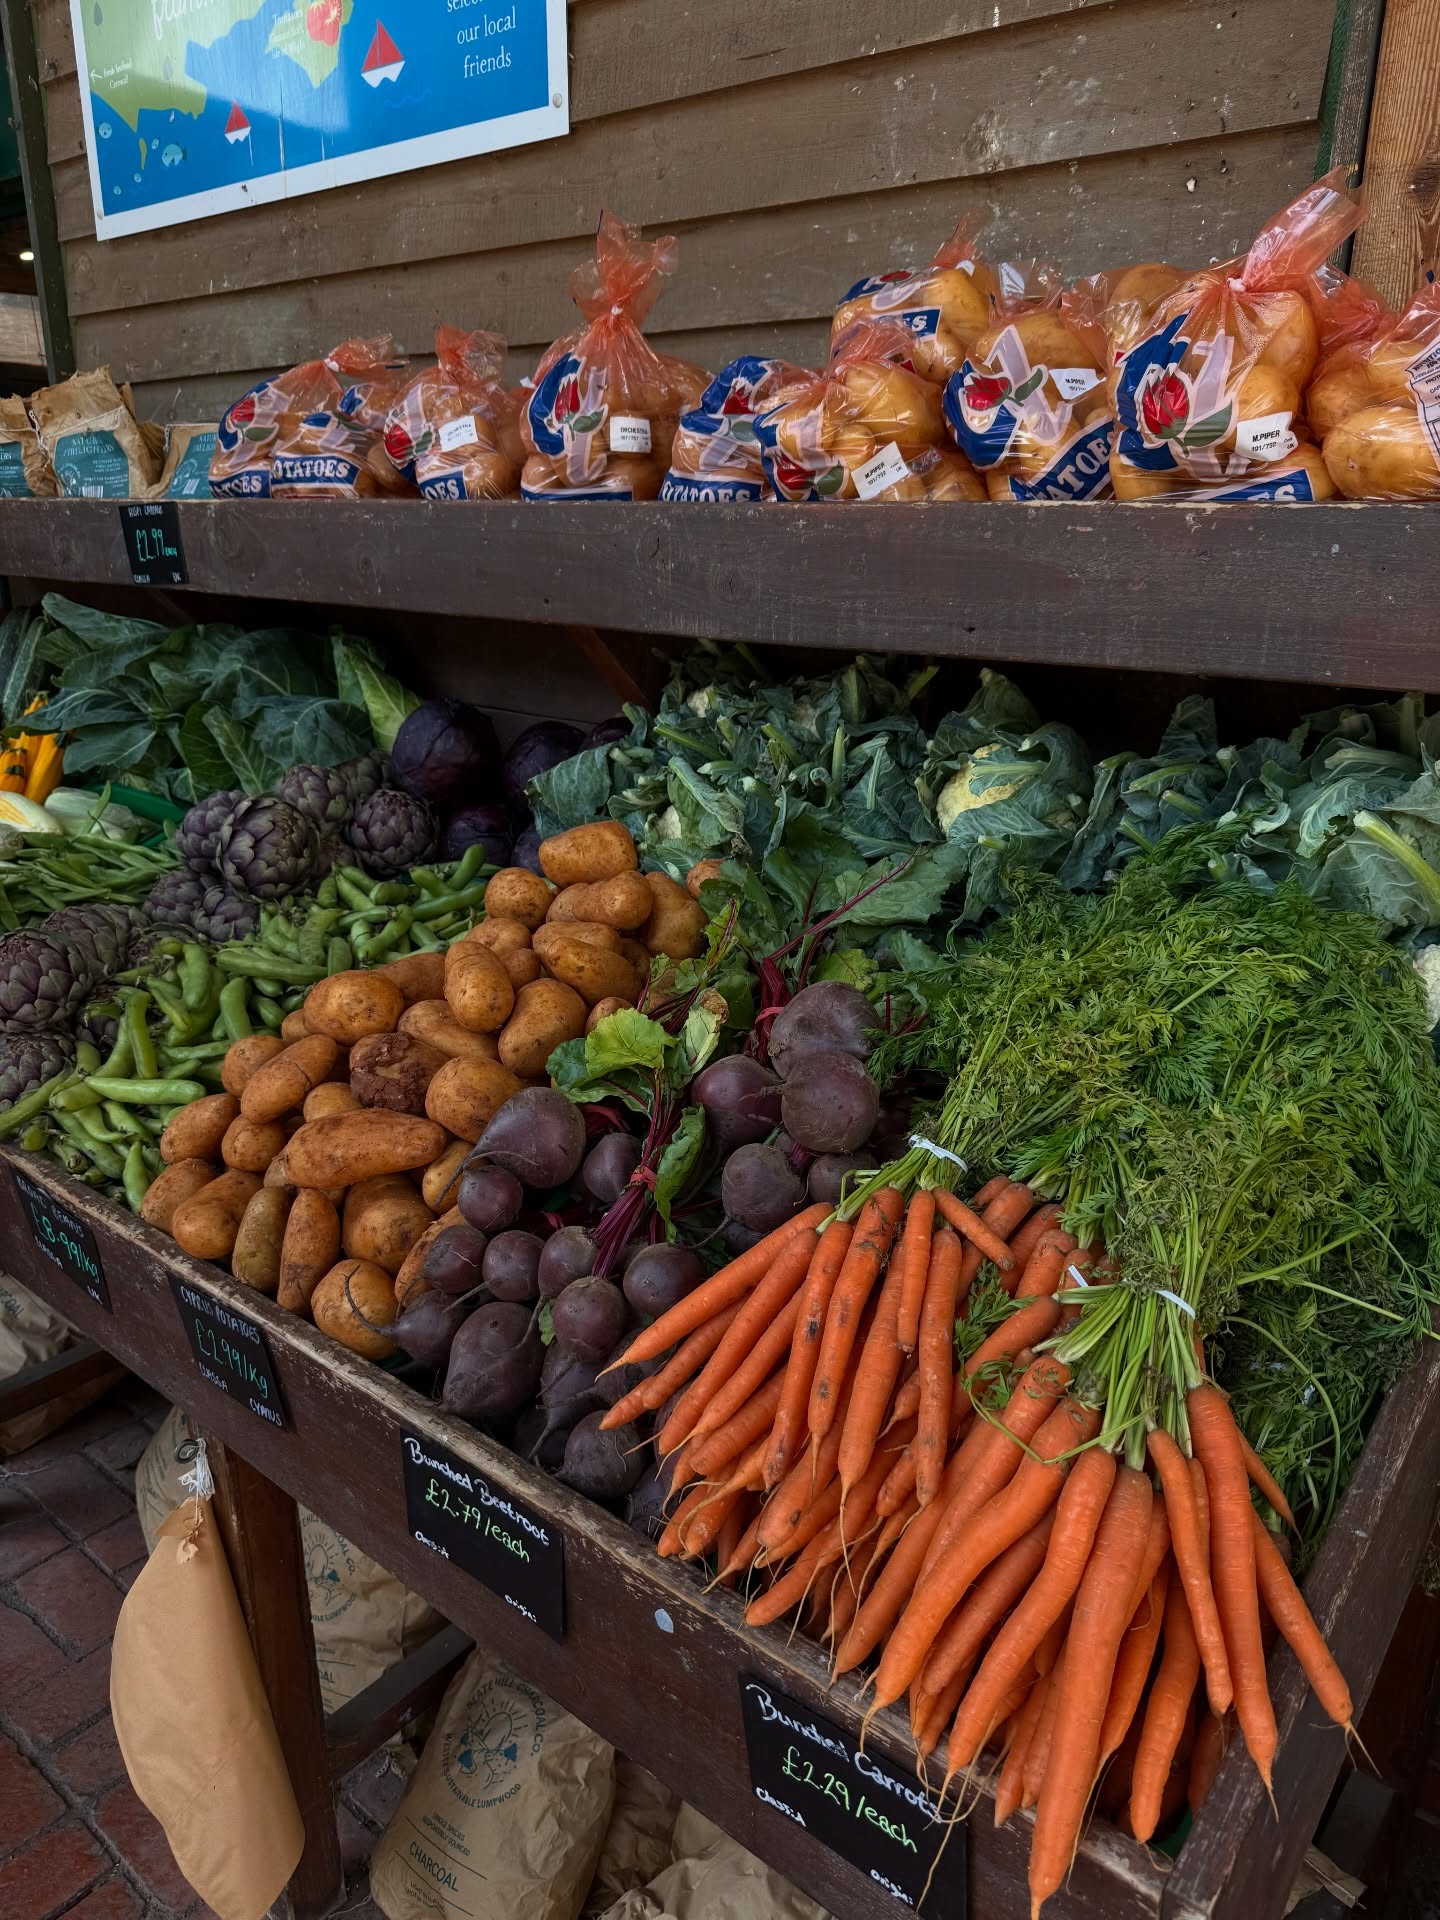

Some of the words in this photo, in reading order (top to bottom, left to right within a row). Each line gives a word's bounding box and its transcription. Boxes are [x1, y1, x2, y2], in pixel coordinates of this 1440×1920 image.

[457, 25, 480, 44] our
[484, 5, 517, 37] local
[464, 45, 512, 78] friends
[1252, 430, 1281, 442] M.PIPER
[864, 461, 886, 479] M.PIPER
[180, 1286, 214, 1316] CYPRUS
[215, 1305, 260, 1345] POTATOES
[249, 1397, 283, 1427] CYPRUS
[404, 1438, 474, 1493] Bunched
[474, 1479, 550, 1547] Beetroot
[745, 1683, 850, 1763] Bunched
[854, 1751, 942, 1823] Carrots
[476, 1782, 522, 1809] LUMPWOOD
[408, 1841, 459, 1893] CHARCOAL
